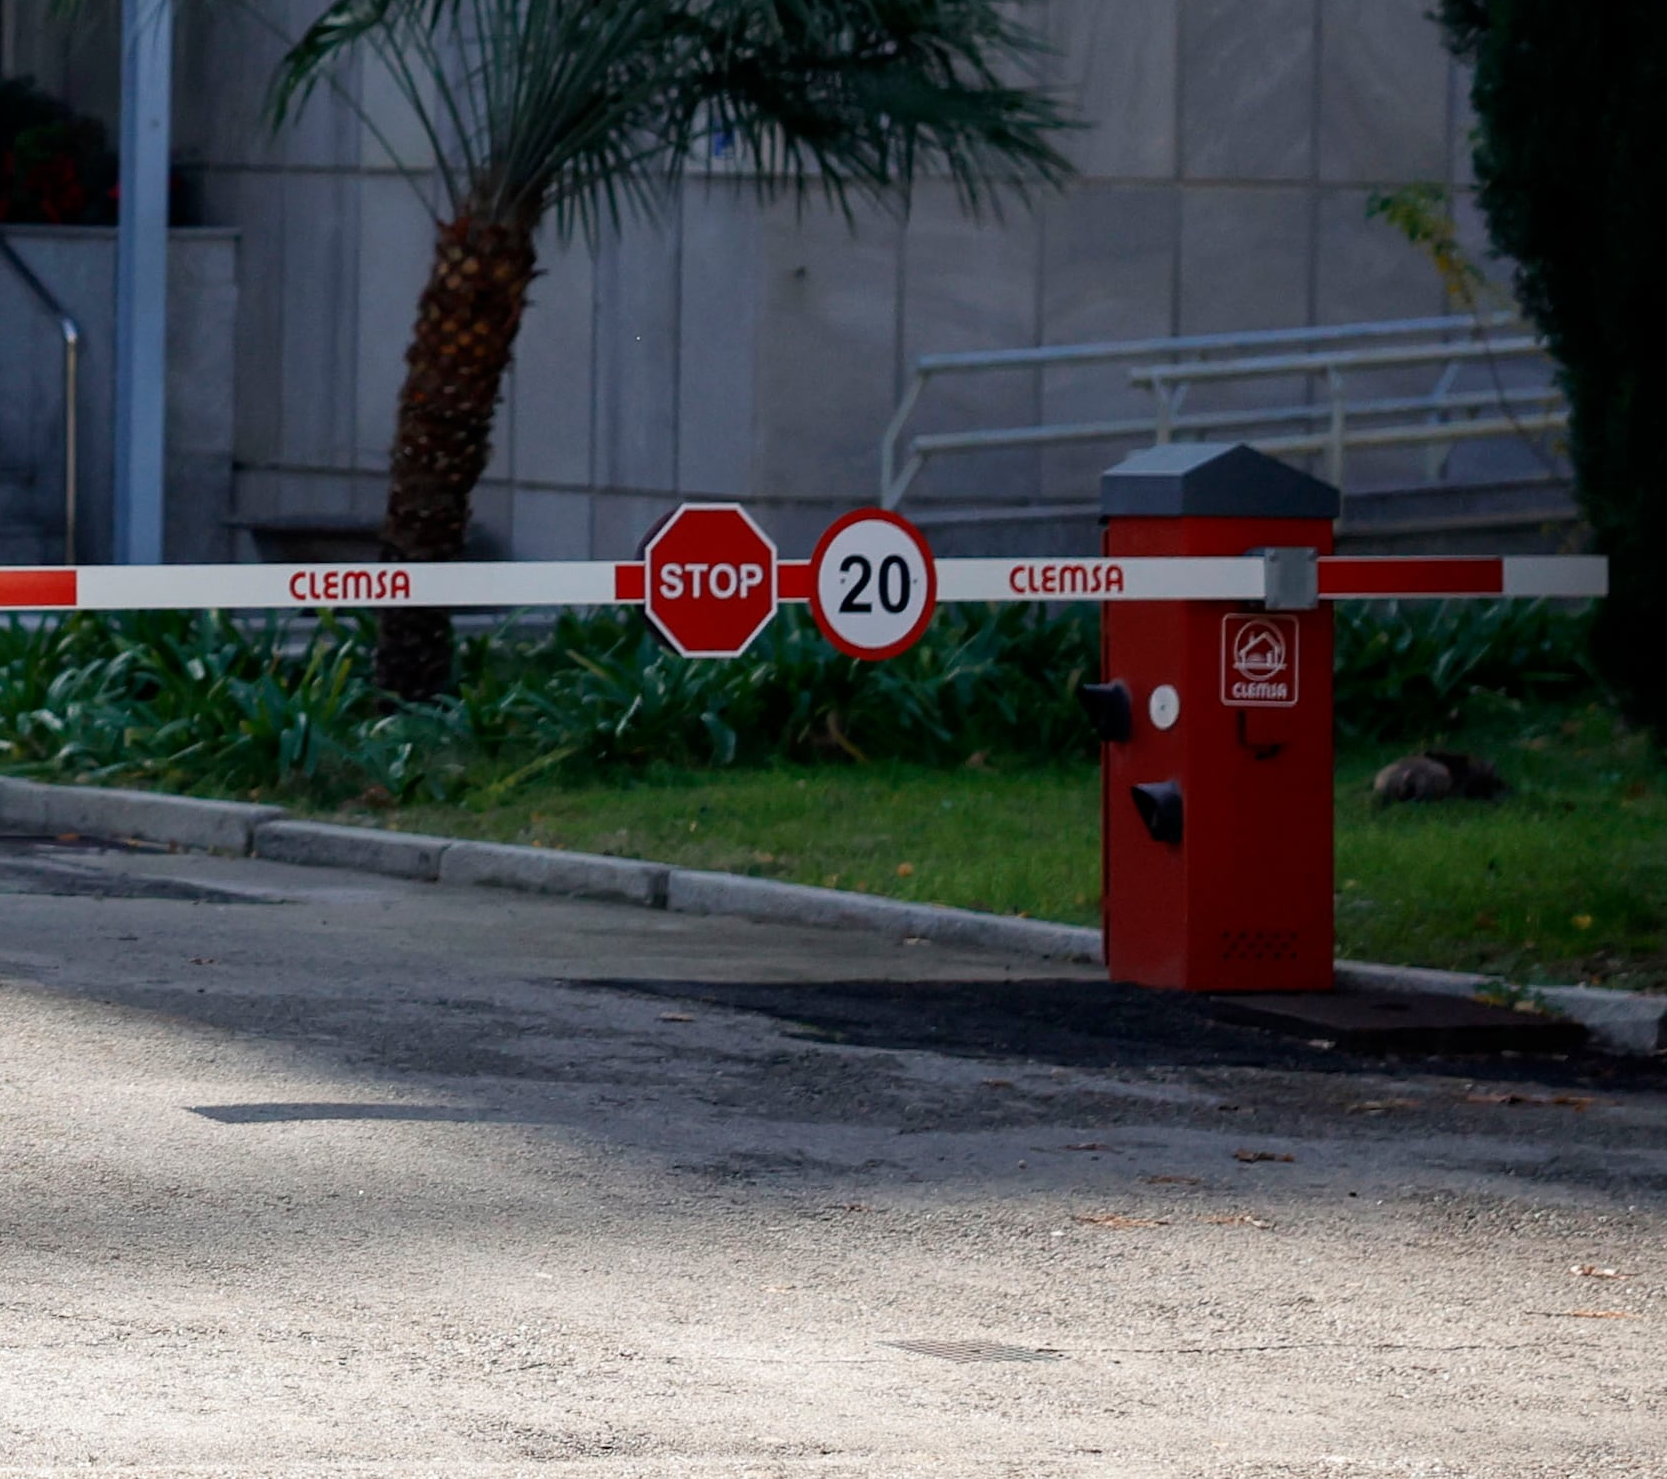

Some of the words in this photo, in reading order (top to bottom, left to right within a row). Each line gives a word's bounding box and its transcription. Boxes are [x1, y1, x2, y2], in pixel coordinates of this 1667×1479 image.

[289, 570, 410, 601] CLEMSA
[659, 563, 764, 600] STOP
[839, 554, 912, 614] 20
[1009, 565, 1124, 595] CLEMSA
